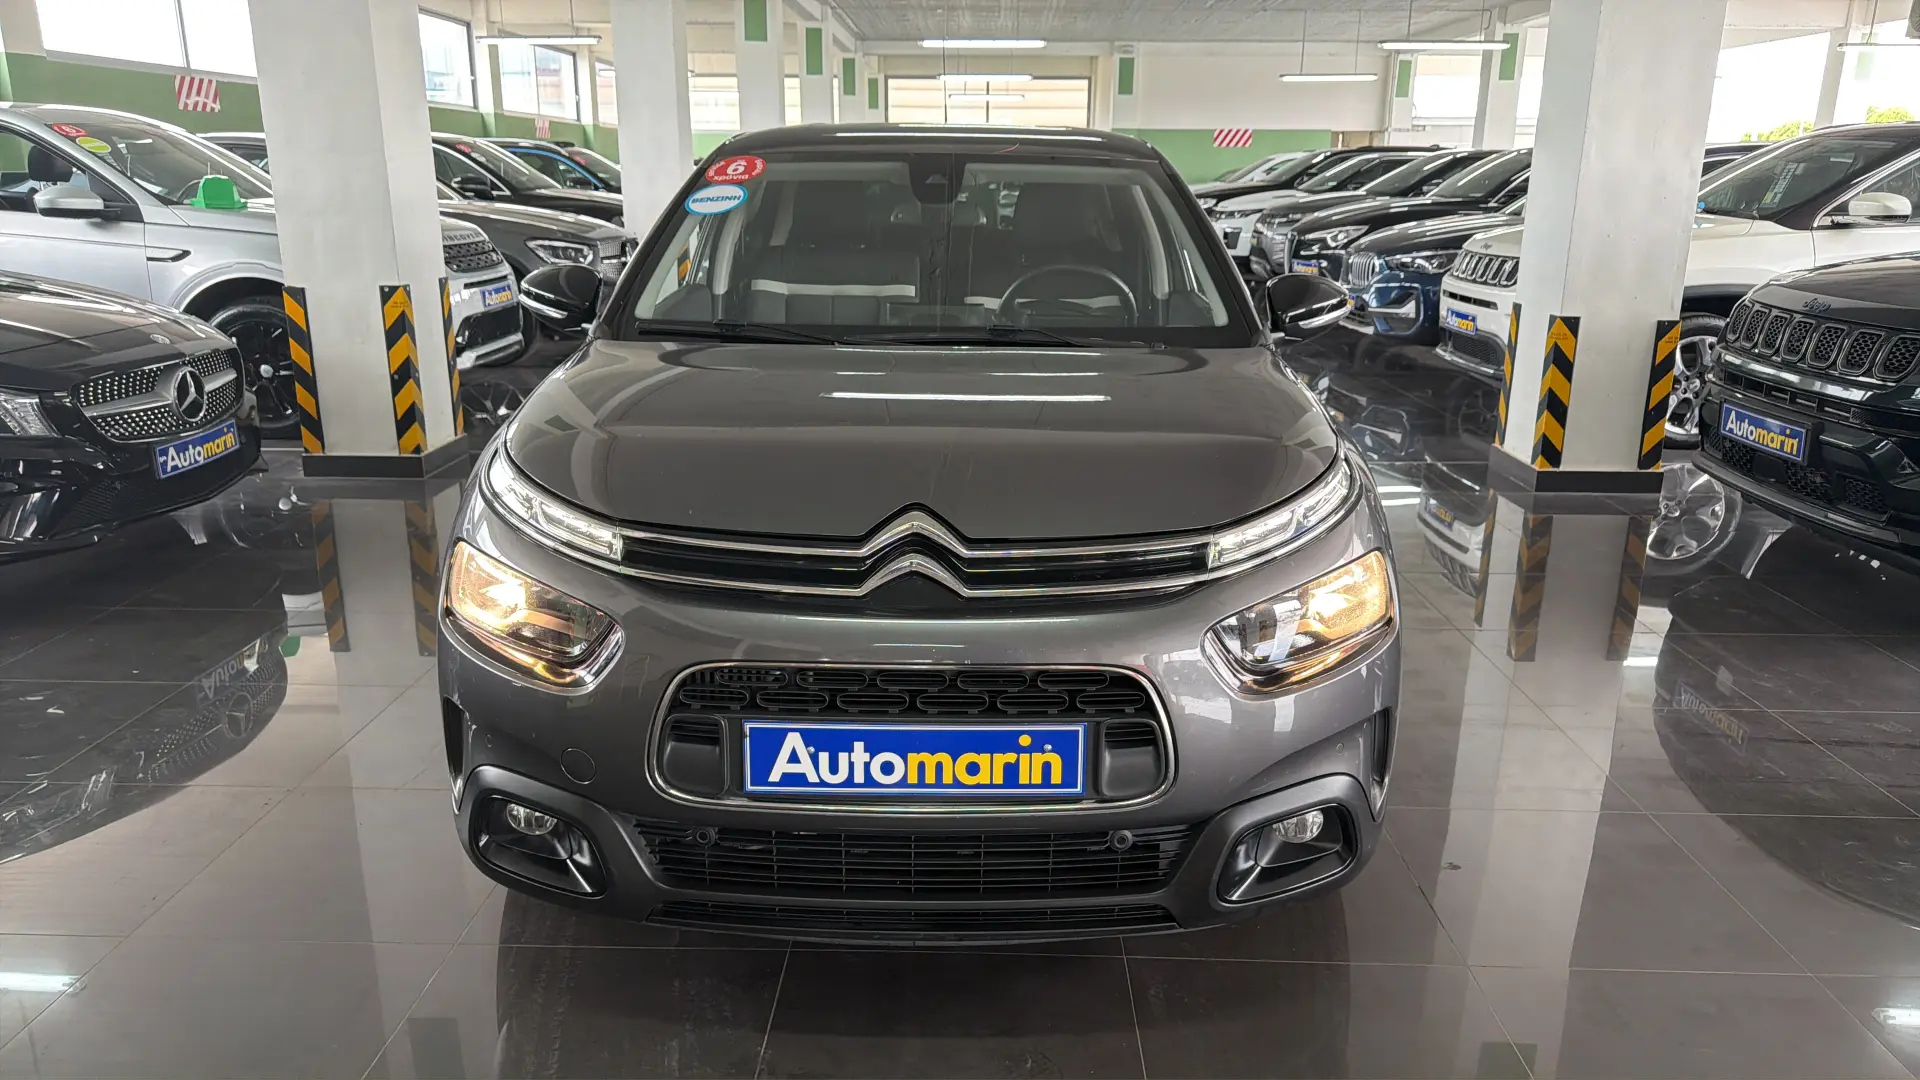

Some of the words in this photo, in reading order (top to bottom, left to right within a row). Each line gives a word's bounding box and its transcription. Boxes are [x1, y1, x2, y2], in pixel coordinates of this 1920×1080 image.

[726, 160, 747, 175] 6
[166, 426, 236, 473] Automarin
[1725, 409, 1800, 455] Automarin
[767, 731, 1062, 786] Automarin
